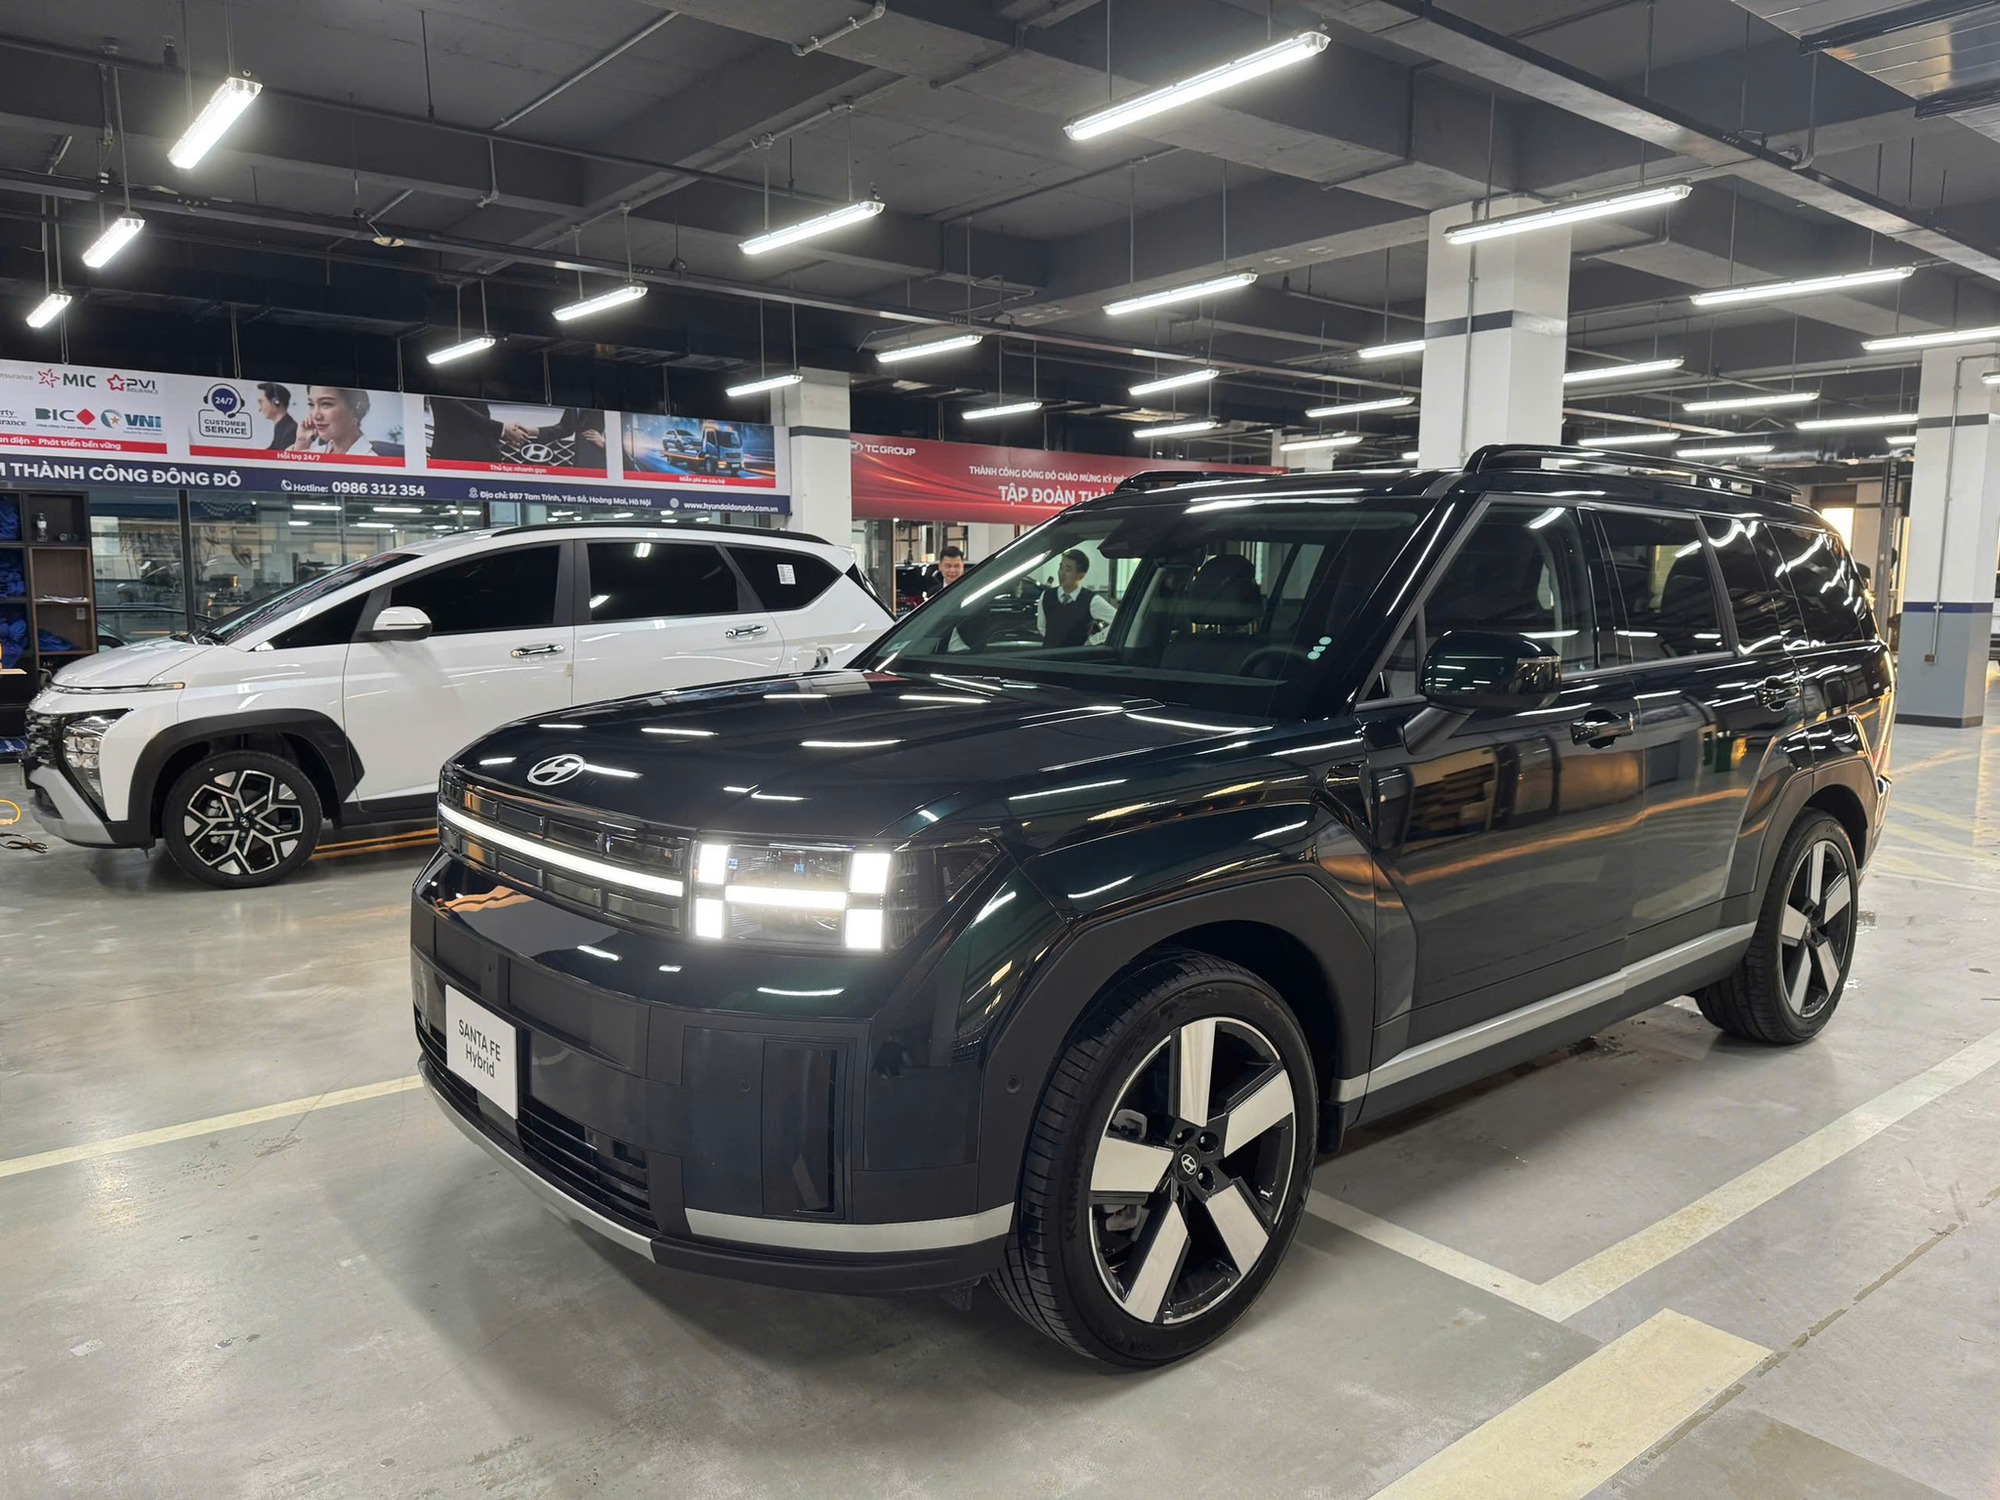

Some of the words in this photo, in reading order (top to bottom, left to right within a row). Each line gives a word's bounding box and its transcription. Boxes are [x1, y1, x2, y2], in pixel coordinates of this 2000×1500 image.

[63, 373, 96, 388] MIC
[127, 378, 156, 390] PVI
[214, 397, 234, 405] 24/7
[35, 407, 75, 422] BIC
[125, 414, 162, 428] VNI
[204, 419, 247, 427] CUSTOMER
[205, 425, 248, 435] SERVICE
[38, 438, 59, 446] Phát
[303, 453, 321, 461] 24/7
[865, 444, 879, 453] TC
[880, 445, 916, 456] GROUP
[10, 460, 85, 480] THÀNH
[89, 464, 148, 483] CÔNG
[152, 467, 210, 486] ĐÔNG
[213, 469, 242, 487] ĐÔ
[969, 464, 997, 476] THÀNH
[998, 465, 1020, 478] CÔNG
[1021, 467, 1044, 480] ĐÔNG
[1045, 468, 1057, 480] ĐÔ
[1057, 470, 1078, 482] CHÀO
[294, 482, 328, 493] Hotline:
[332, 481, 368, 495] 0986
[371, 483, 397, 496] 312
[399, 484, 426, 497] 354
[998, 482, 1029, 506] TẬP
[1031, 485, 1075, 505] ĐOÀN
[480, 490, 494, 500] Địa
[509, 492, 523, 500] 987
[524, 493, 540, 501] Tam
[589, 496, 612, 505] Hoàng
[683, 500, 779, 513] www.hyundaidongdo.com.vn
[458, 1019, 488, 1053] SANTA
[490, 1040, 502, 1062] FE
[465, 1044, 495, 1078] Hybrid
